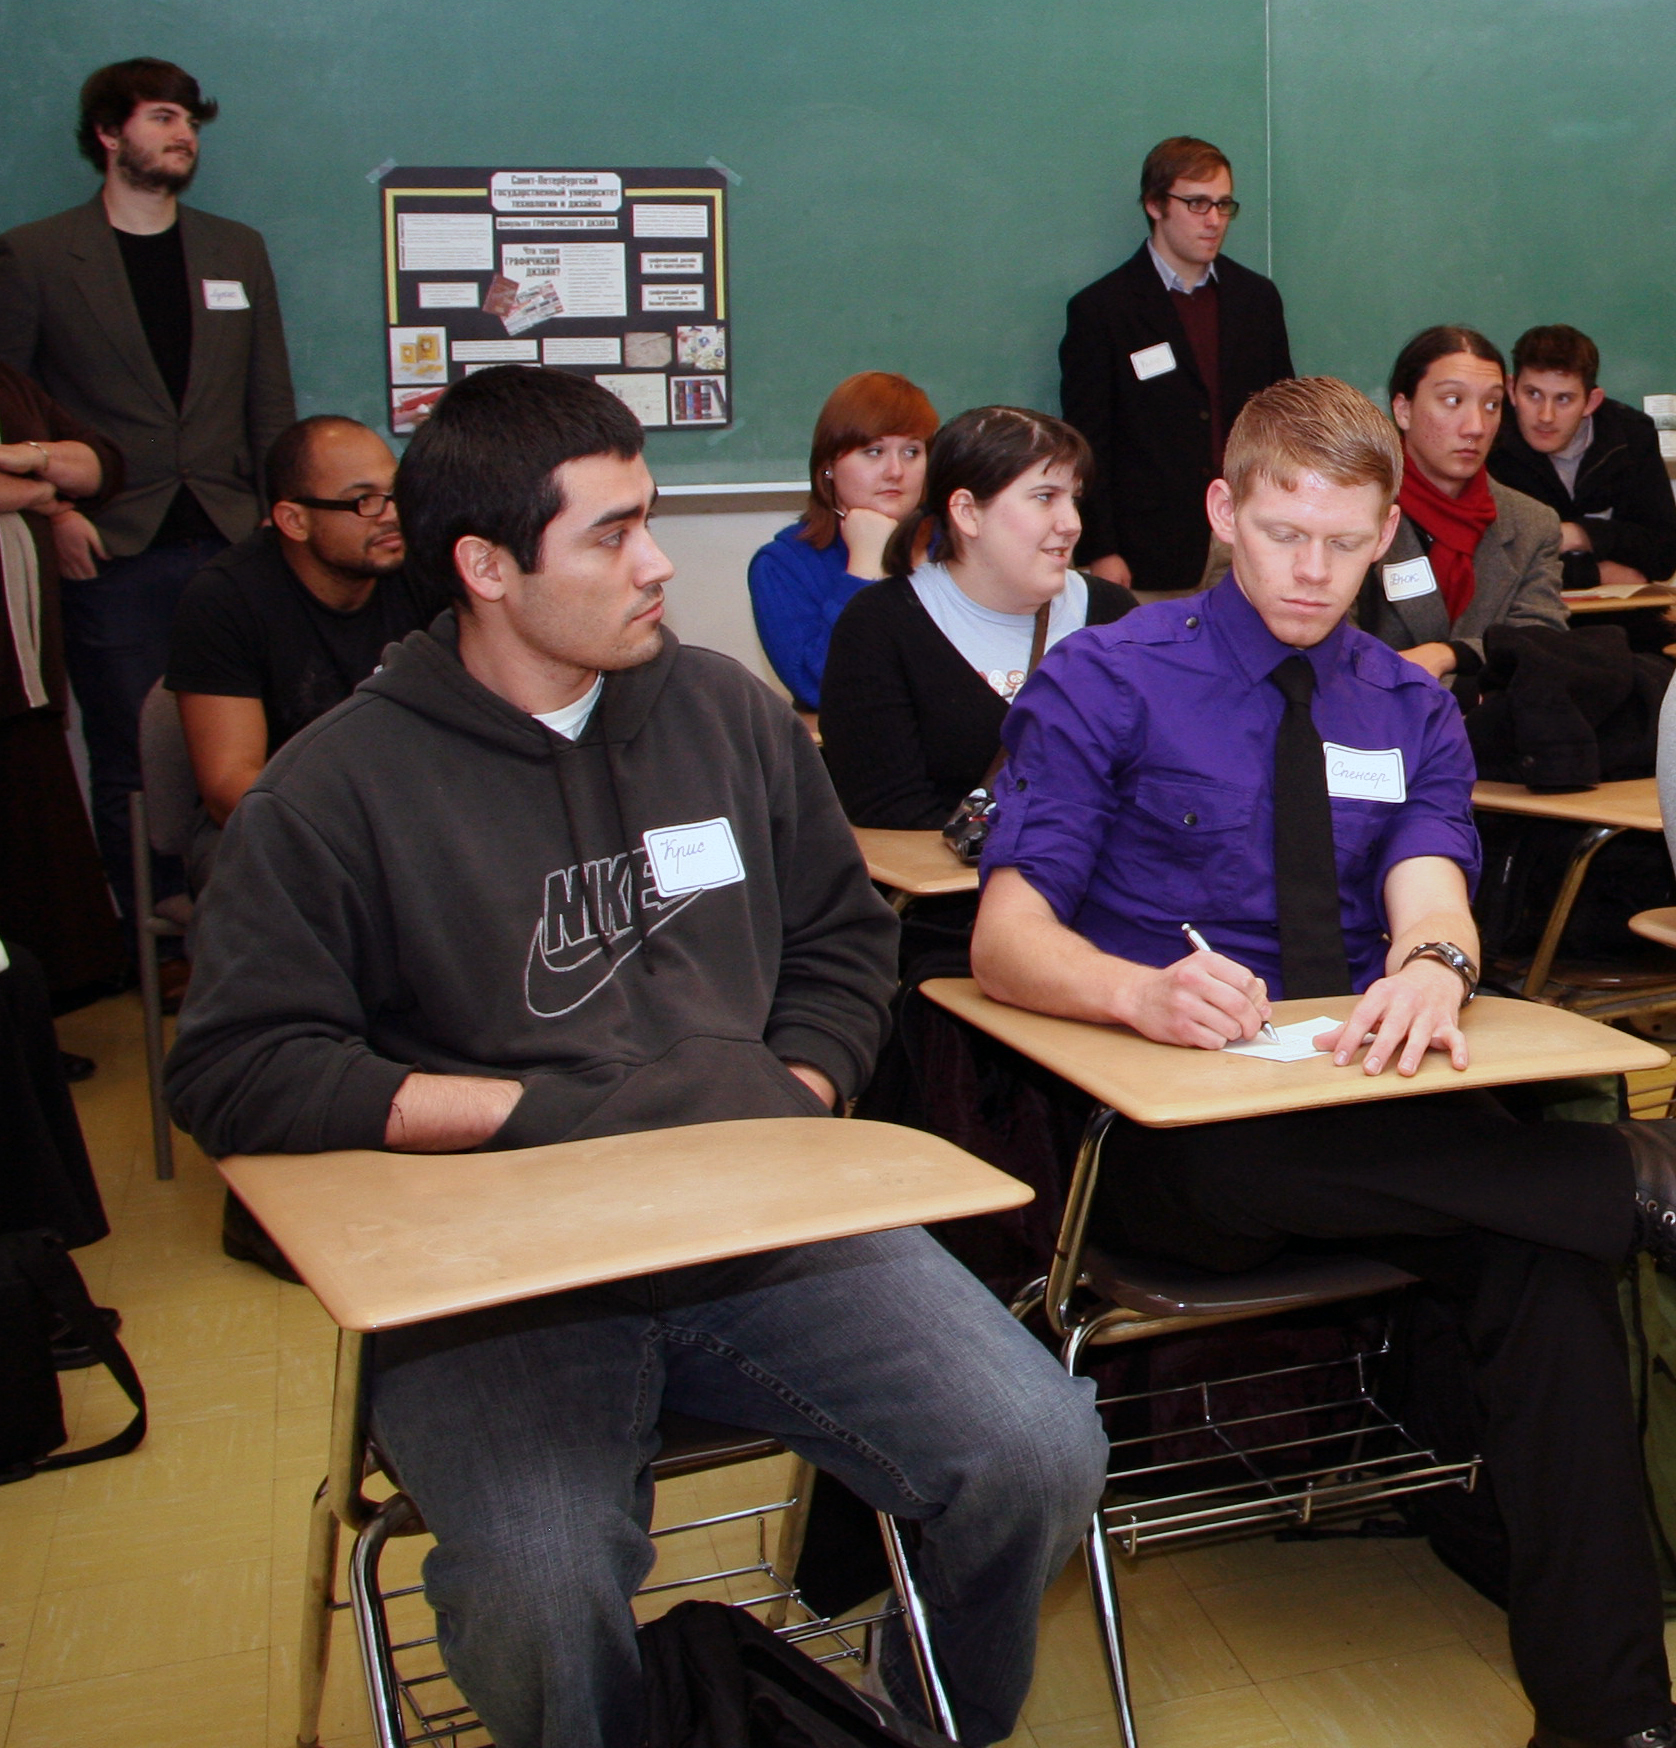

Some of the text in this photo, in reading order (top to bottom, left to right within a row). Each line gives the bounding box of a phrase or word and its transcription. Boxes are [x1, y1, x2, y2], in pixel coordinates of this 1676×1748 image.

[511, 175, 598, 186] Санкт-Петербургский
[494, 188, 618, 198] государственный университет
[568, 199, 602, 209] дизайна
[523, 246, 536, 255] Что
[1331, 760, 1391, 790] Спенсер
[659, 838, 706, 875] Крис
